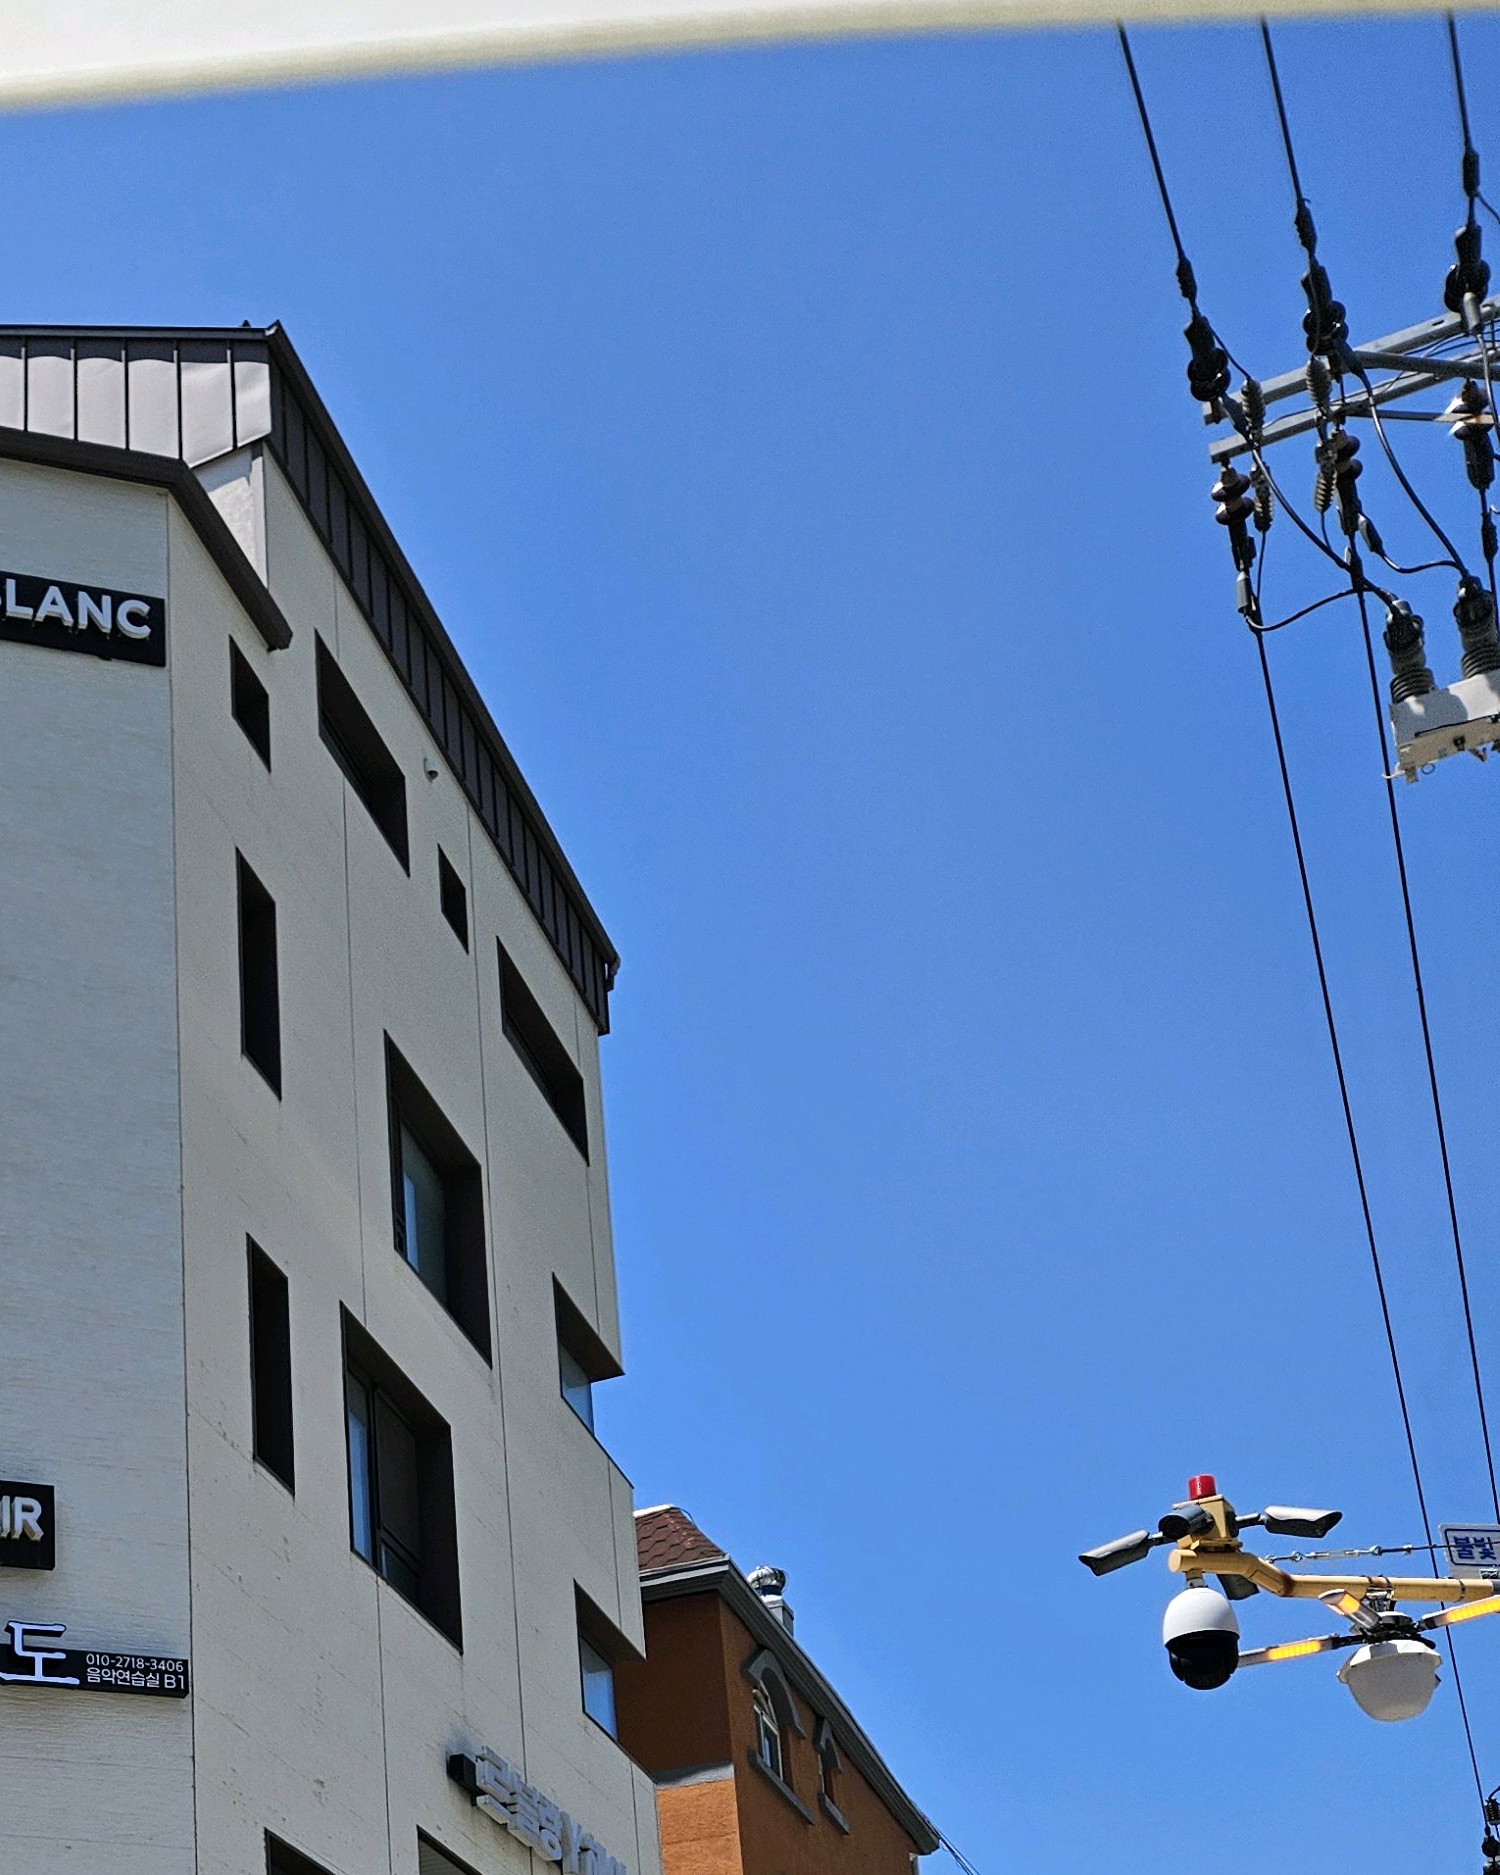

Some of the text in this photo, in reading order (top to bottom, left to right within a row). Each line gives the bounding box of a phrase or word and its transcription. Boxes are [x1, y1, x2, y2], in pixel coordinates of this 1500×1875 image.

[85, 1653, 185, 1673] 010-2718-3406
[86, 1667, 185, 1690] 음악연습실 B1
